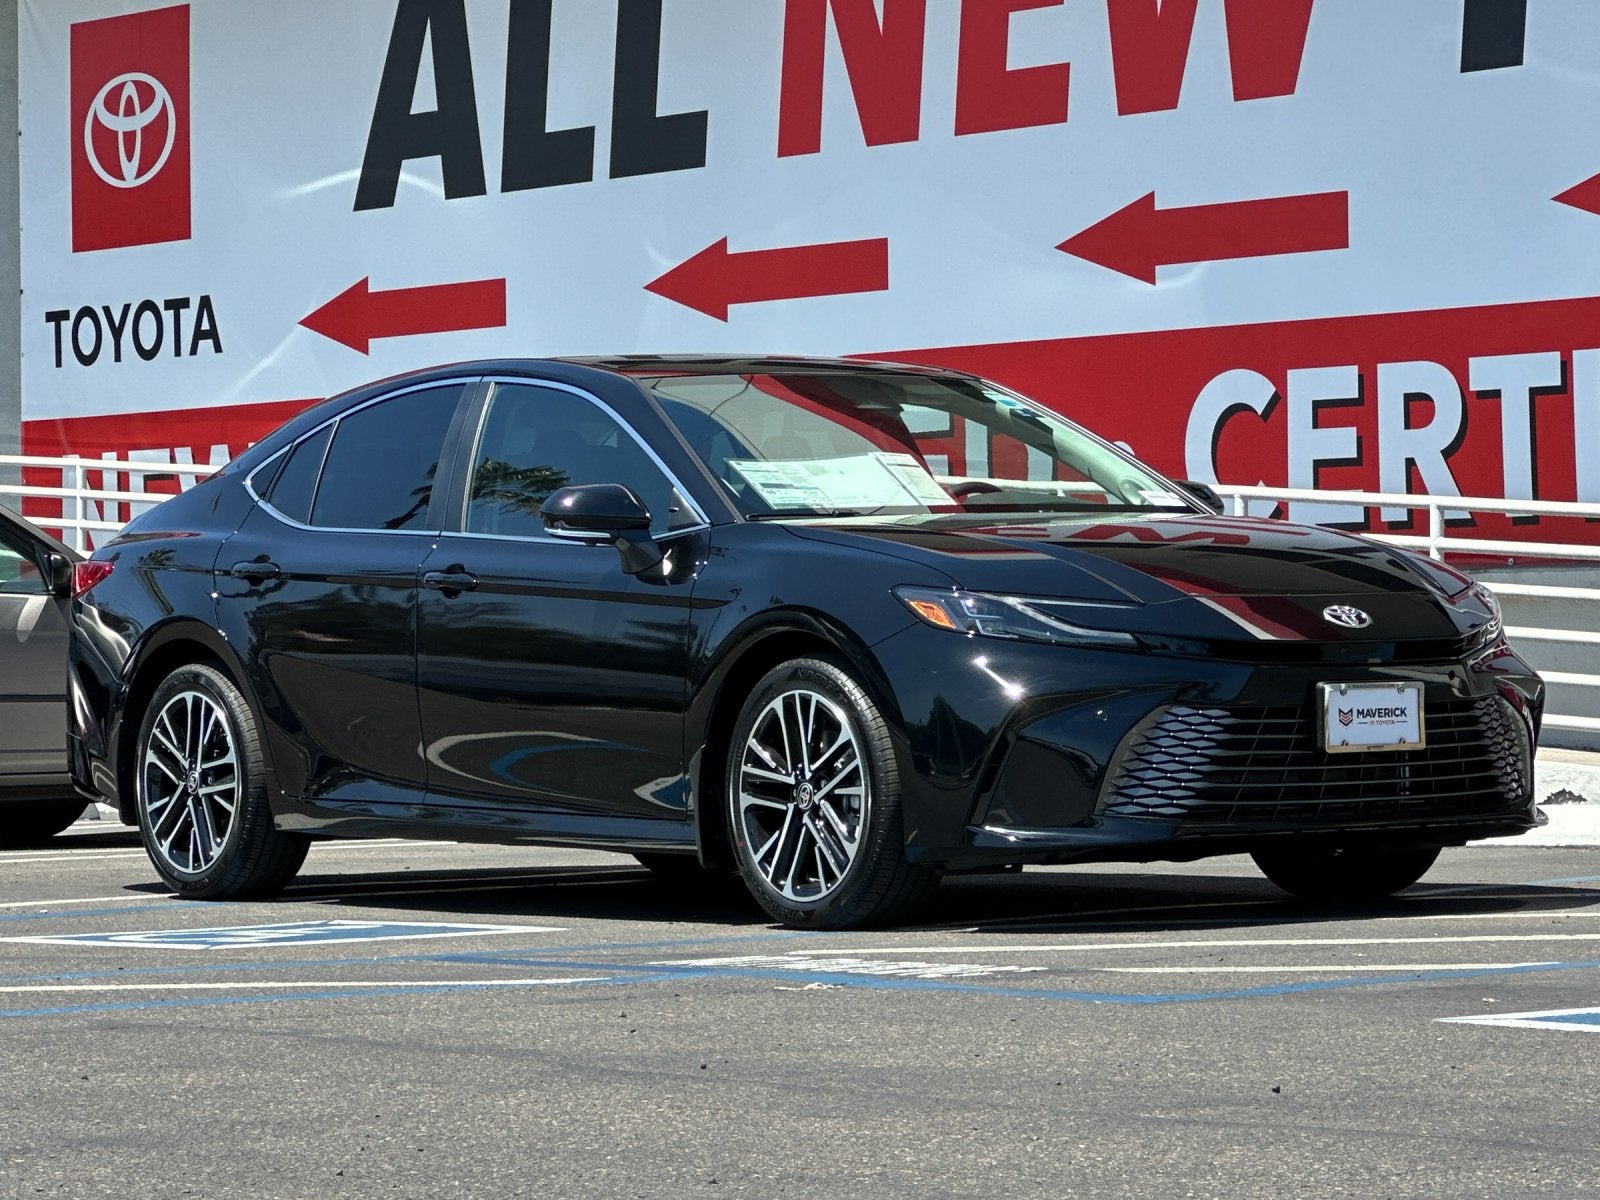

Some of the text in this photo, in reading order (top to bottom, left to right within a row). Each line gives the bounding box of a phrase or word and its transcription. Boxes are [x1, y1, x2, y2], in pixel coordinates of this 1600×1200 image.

[353, 0, 709, 212] ALL
[45, 295, 223, 368] TOYOTA
[1356, 707, 1407, 718] MAVERICK
